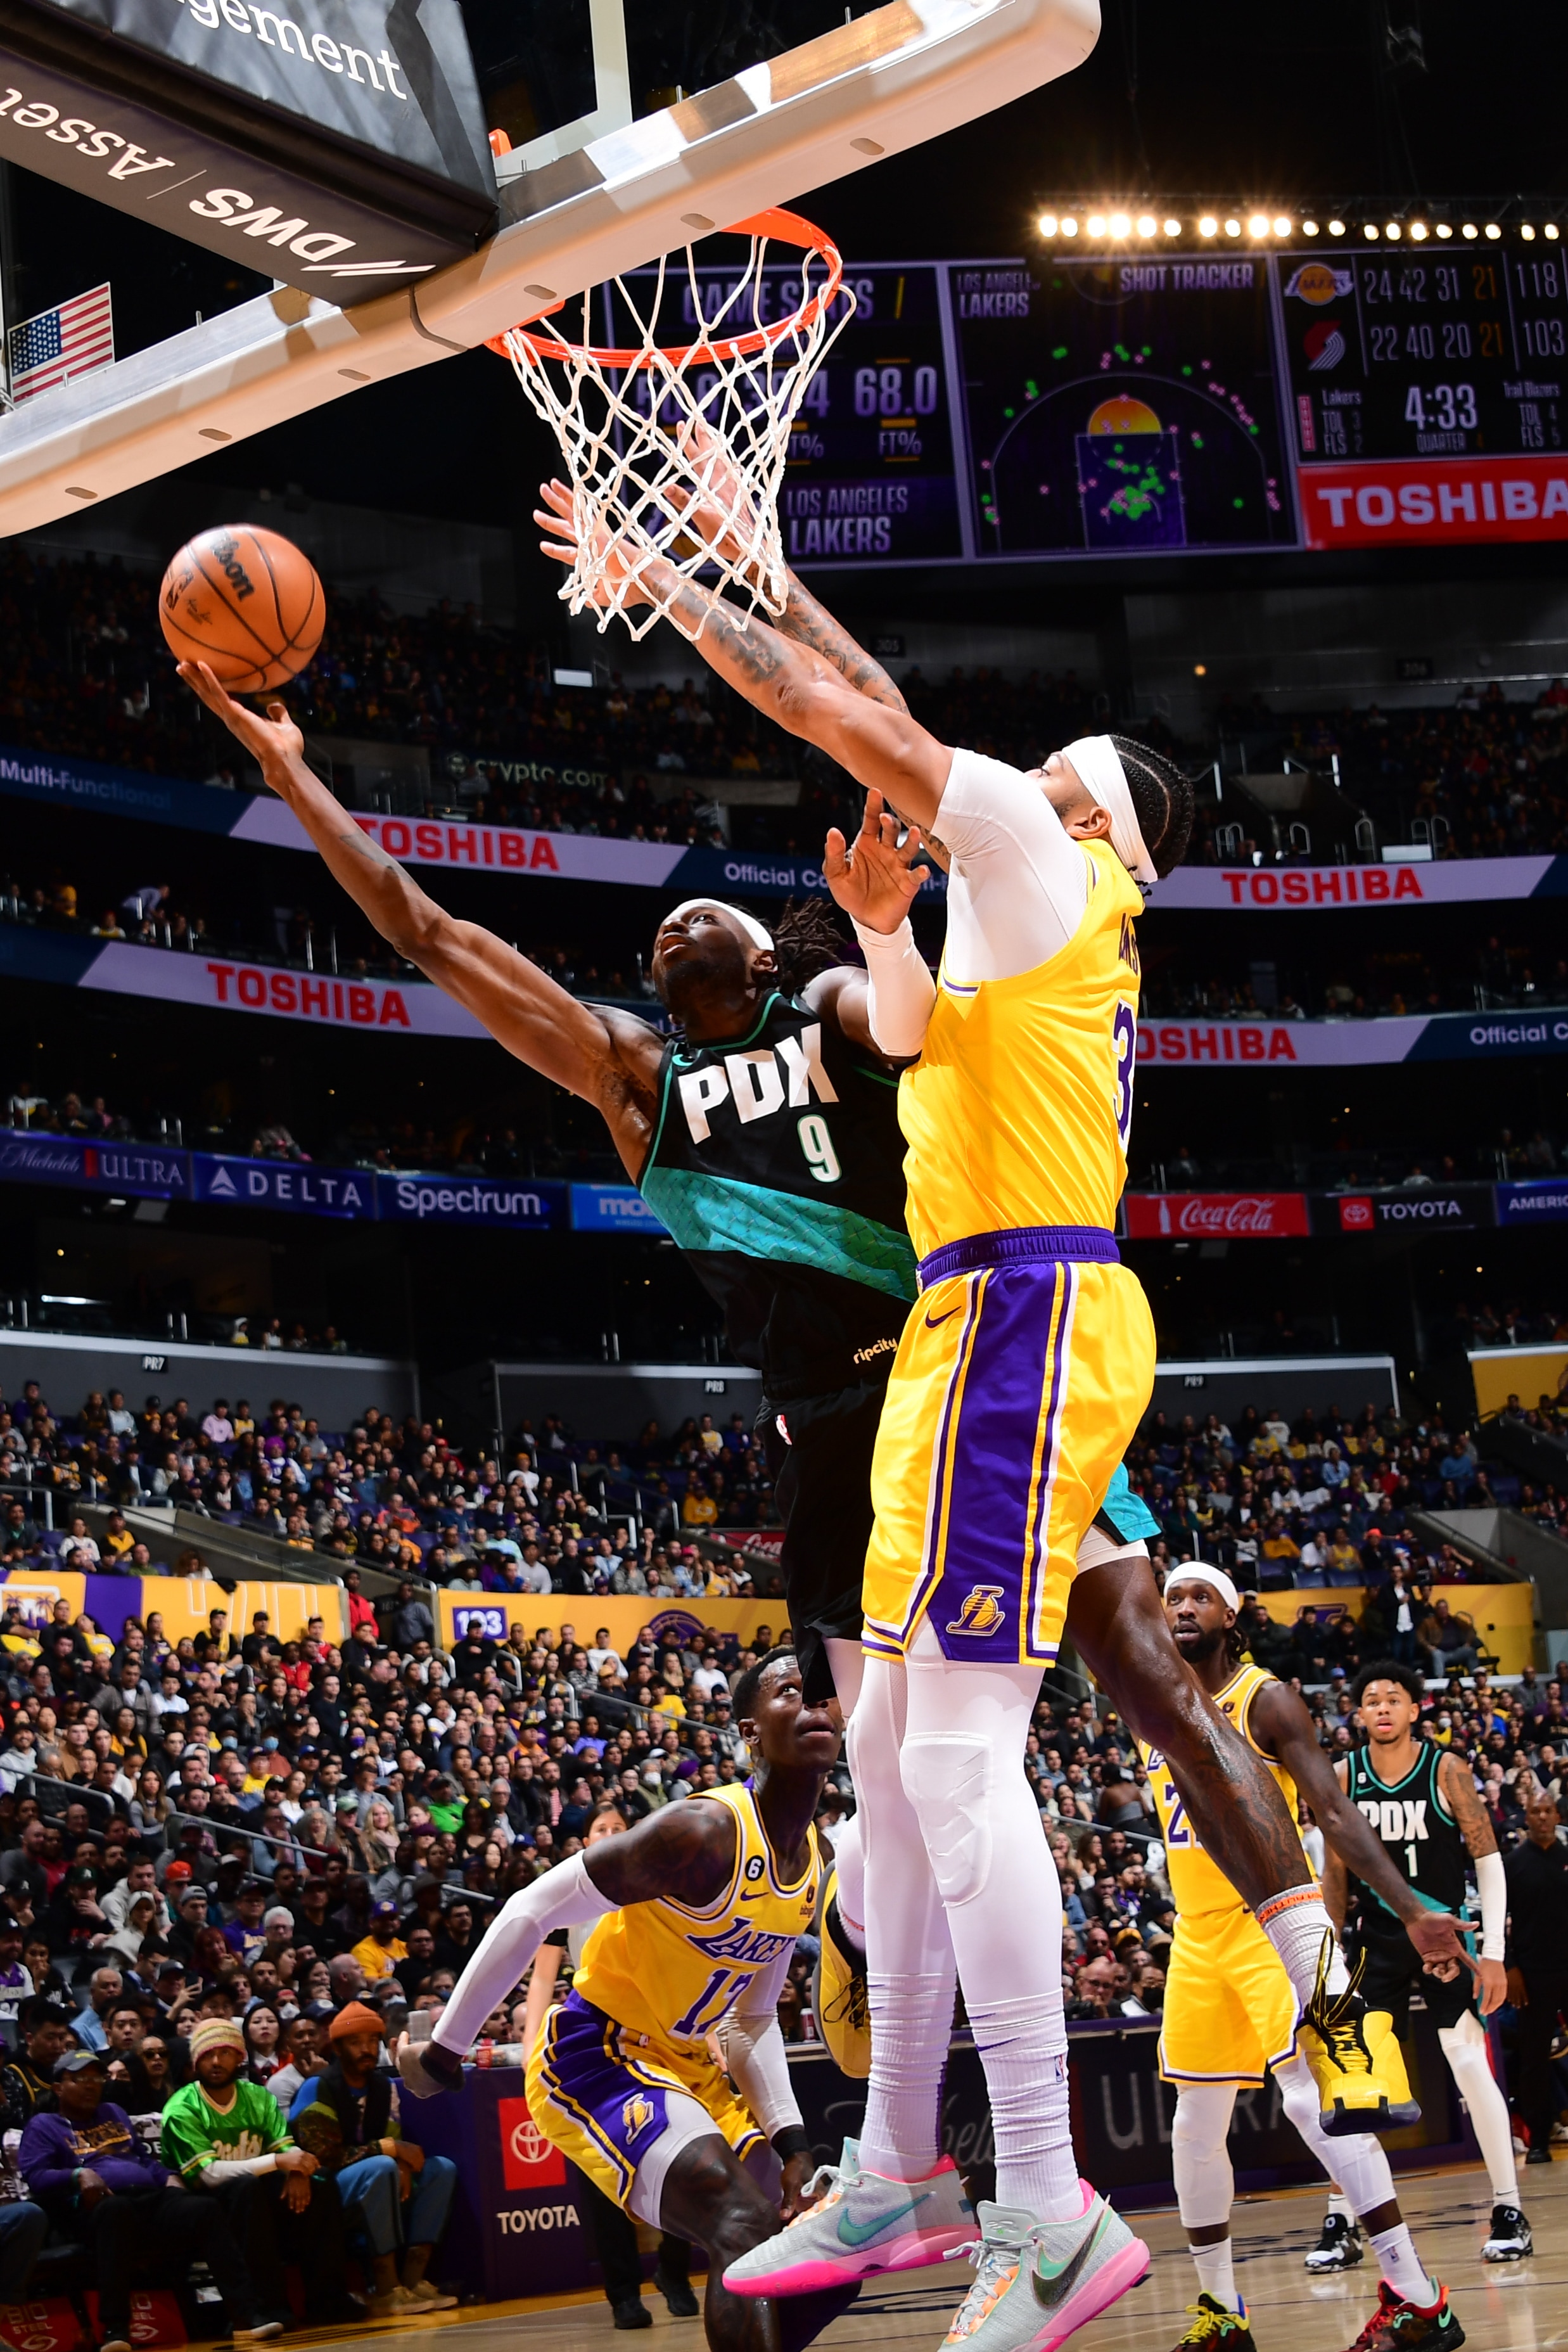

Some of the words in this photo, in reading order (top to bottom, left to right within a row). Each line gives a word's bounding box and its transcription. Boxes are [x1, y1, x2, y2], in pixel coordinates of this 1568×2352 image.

[189, 188, 356, 262] DWS
[1120, 266, 1165, 291] SHOT
[1173, 264, 1253, 289] TRACKER
[1363, 269, 1394, 305] 24
[1434, 265, 1461, 302] 31
[1472, 264, 1498, 301] 21
[1515, 261, 1558, 299] 118
[959, 292, 1029, 318] LAKERS
[1370, 325, 1399, 361] 22
[1406, 325, 1434, 360] 40
[1442, 322, 1472, 359] 20
[1479, 321, 1504, 357] 21
[1522, 318, 1565, 357] 103
[855, 367, 938, 416] 68.0
[1405, 383, 1479, 430] 4:33
[789, 433, 824, 457] T%
[879, 431, 922, 456] FT%
[787, 490, 824, 516] LOS
[827, 487, 908, 513] ANGELES
[1317, 478, 1568, 527] TOSHIBA
[790, 516, 891, 554] LAKERS
[725, 862, 795, 887] Official
[1222, 869, 1423, 903] TOSHIBA
[207, 964, 411, 1026] TOSHIBA
[1136, 1028, 1296, 1061] OSHIBA
[1469, 1023, 1547, 1045] Official
[677, 1022, 840, 1144] PDX
[796, 1113, 843, 1183] 9
[101, 1154, 184, 1186] ULTRA
[249, 1174, 362, 1207] DELTA
[397, 1181, 542, 1217] Spectrum
[1379, 1201, 1462, 1221] TOYOTA
[143, 1356, 165, 1371] PR7
[853, 1338, 898, 1364] ripcity
[1357, 1800, 1429, 1841] PDX
[748, 1858, 762, 1879] 6
[1404, 1844, 1418, 1877] 1
[496, 2204, 581, 2234] TOYOTA
